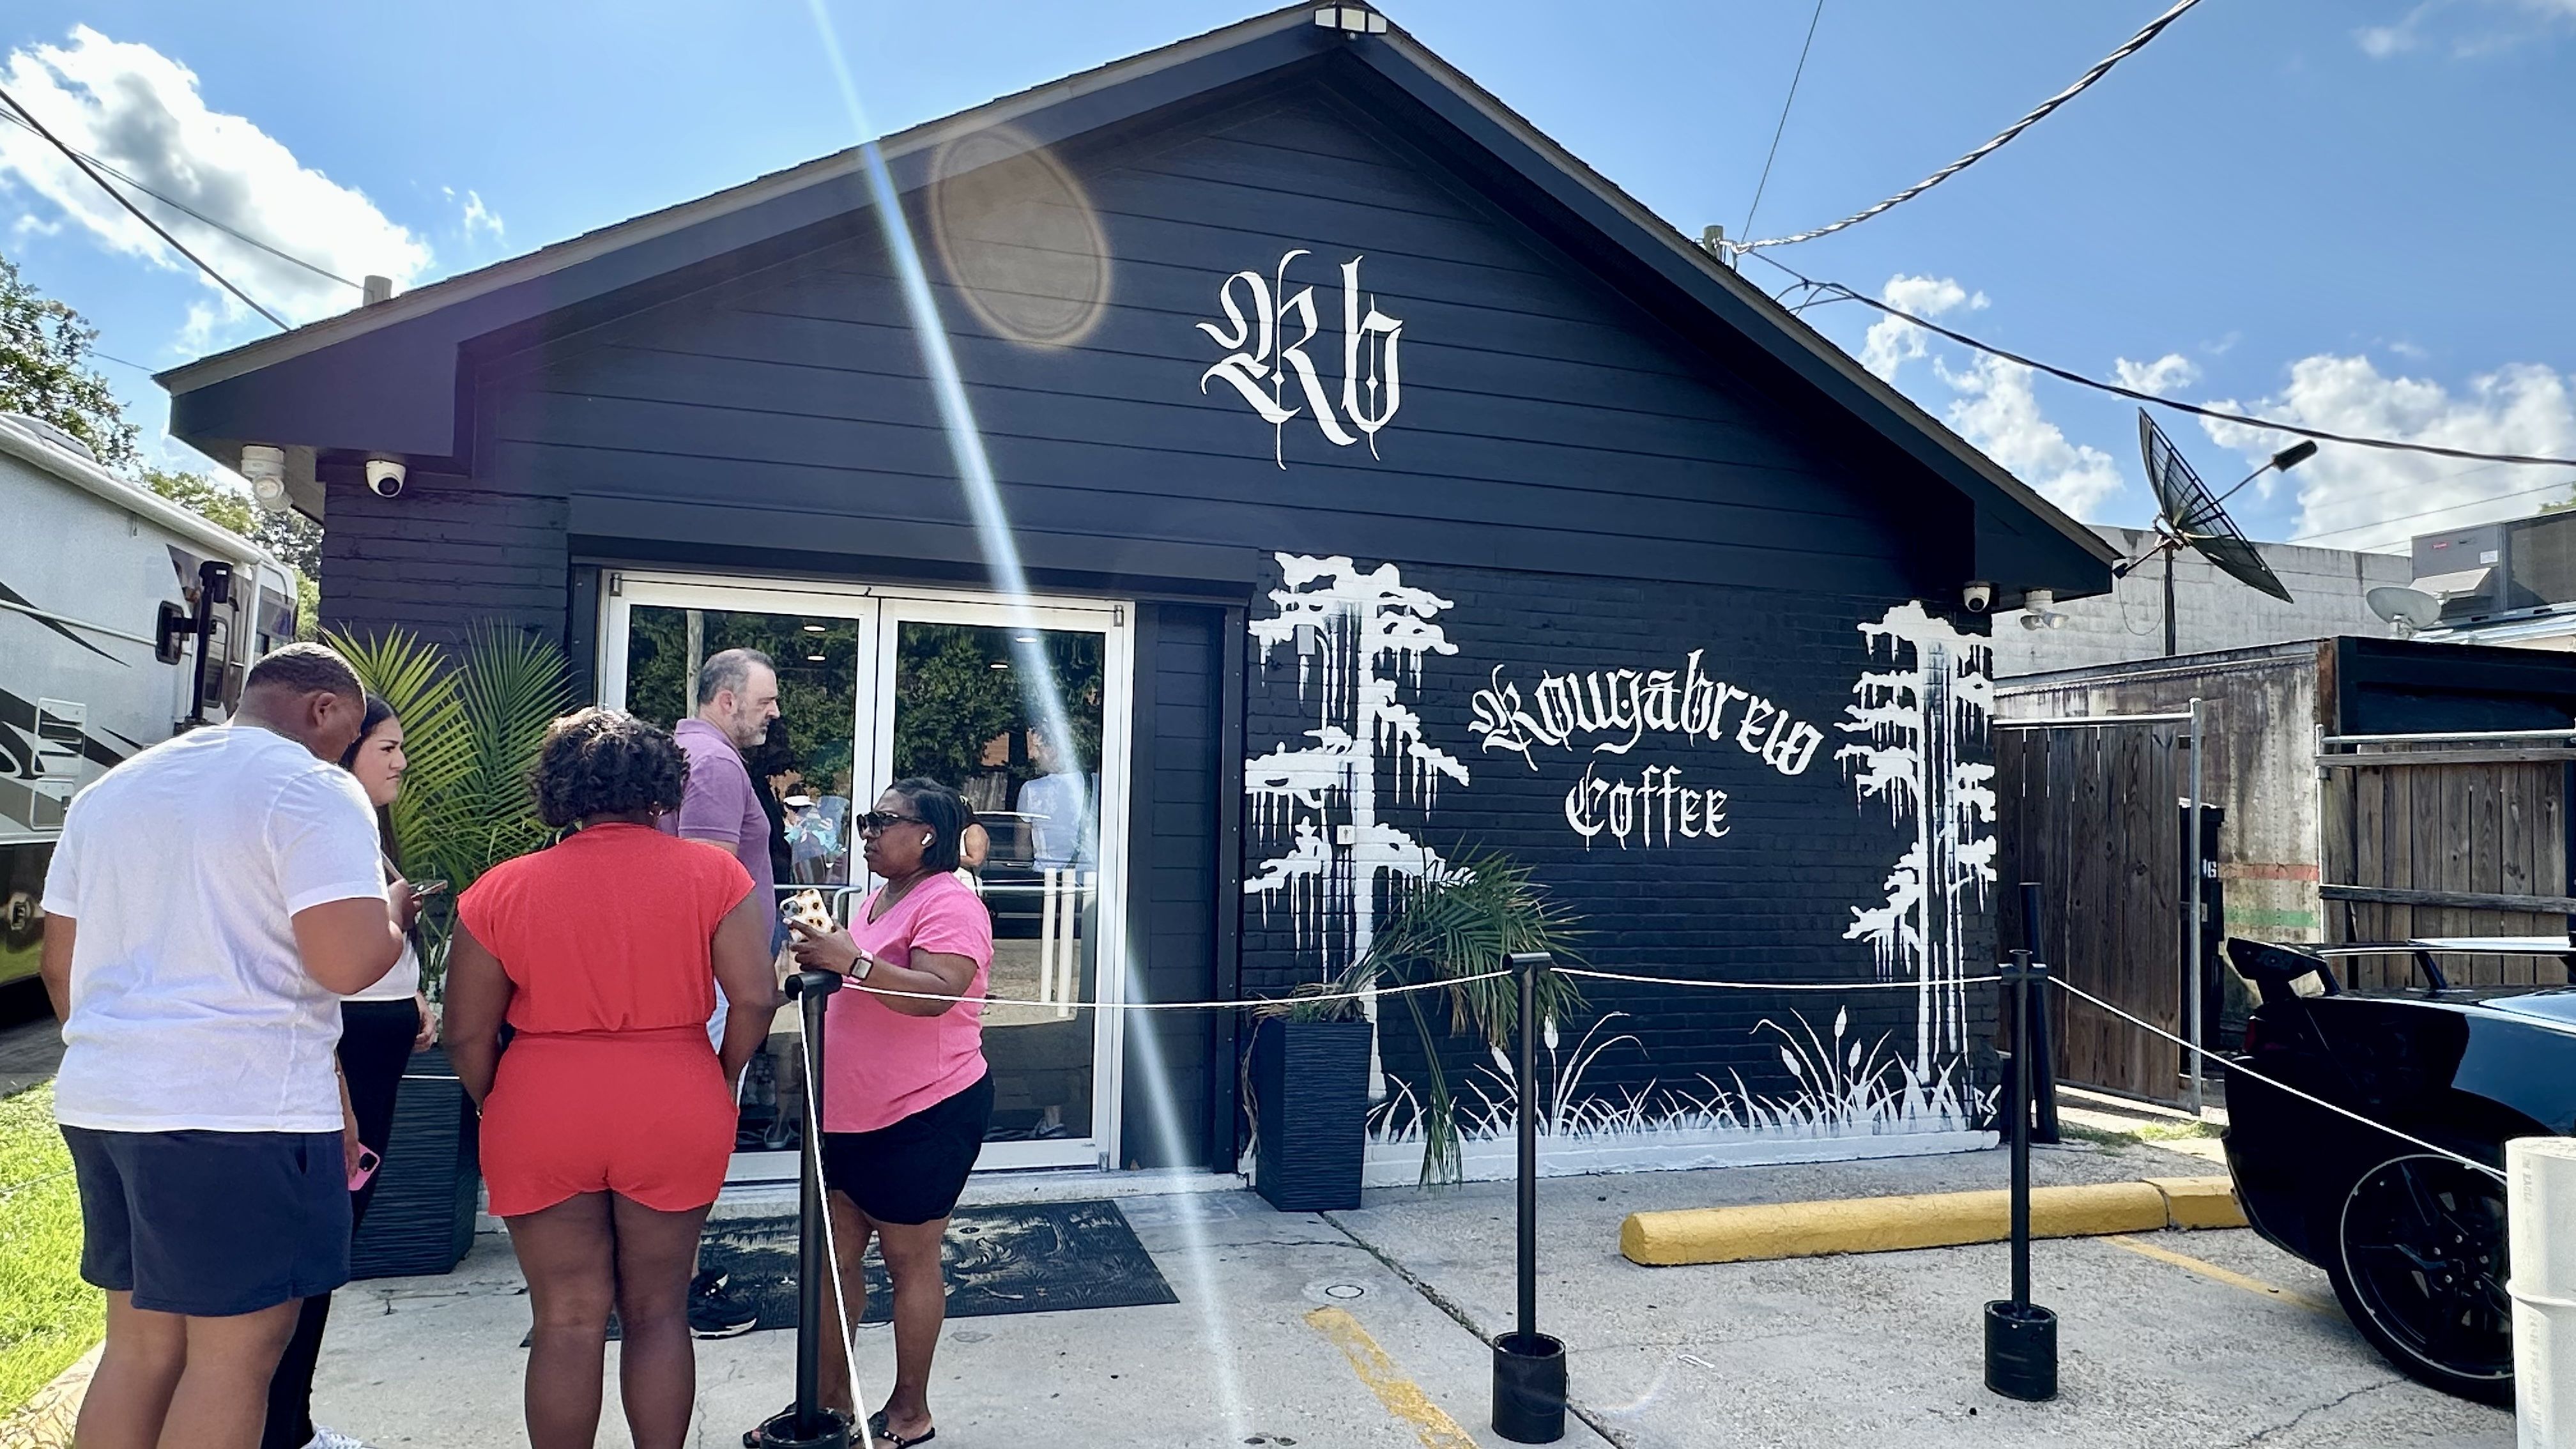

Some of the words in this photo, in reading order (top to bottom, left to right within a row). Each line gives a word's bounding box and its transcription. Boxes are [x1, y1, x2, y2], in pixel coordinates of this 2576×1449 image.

[1195, 249, 1404, 470] Rb
[1468, 648, 1825, 776] Rougabrew
[1565, 760, 1730, 851] Coffee
